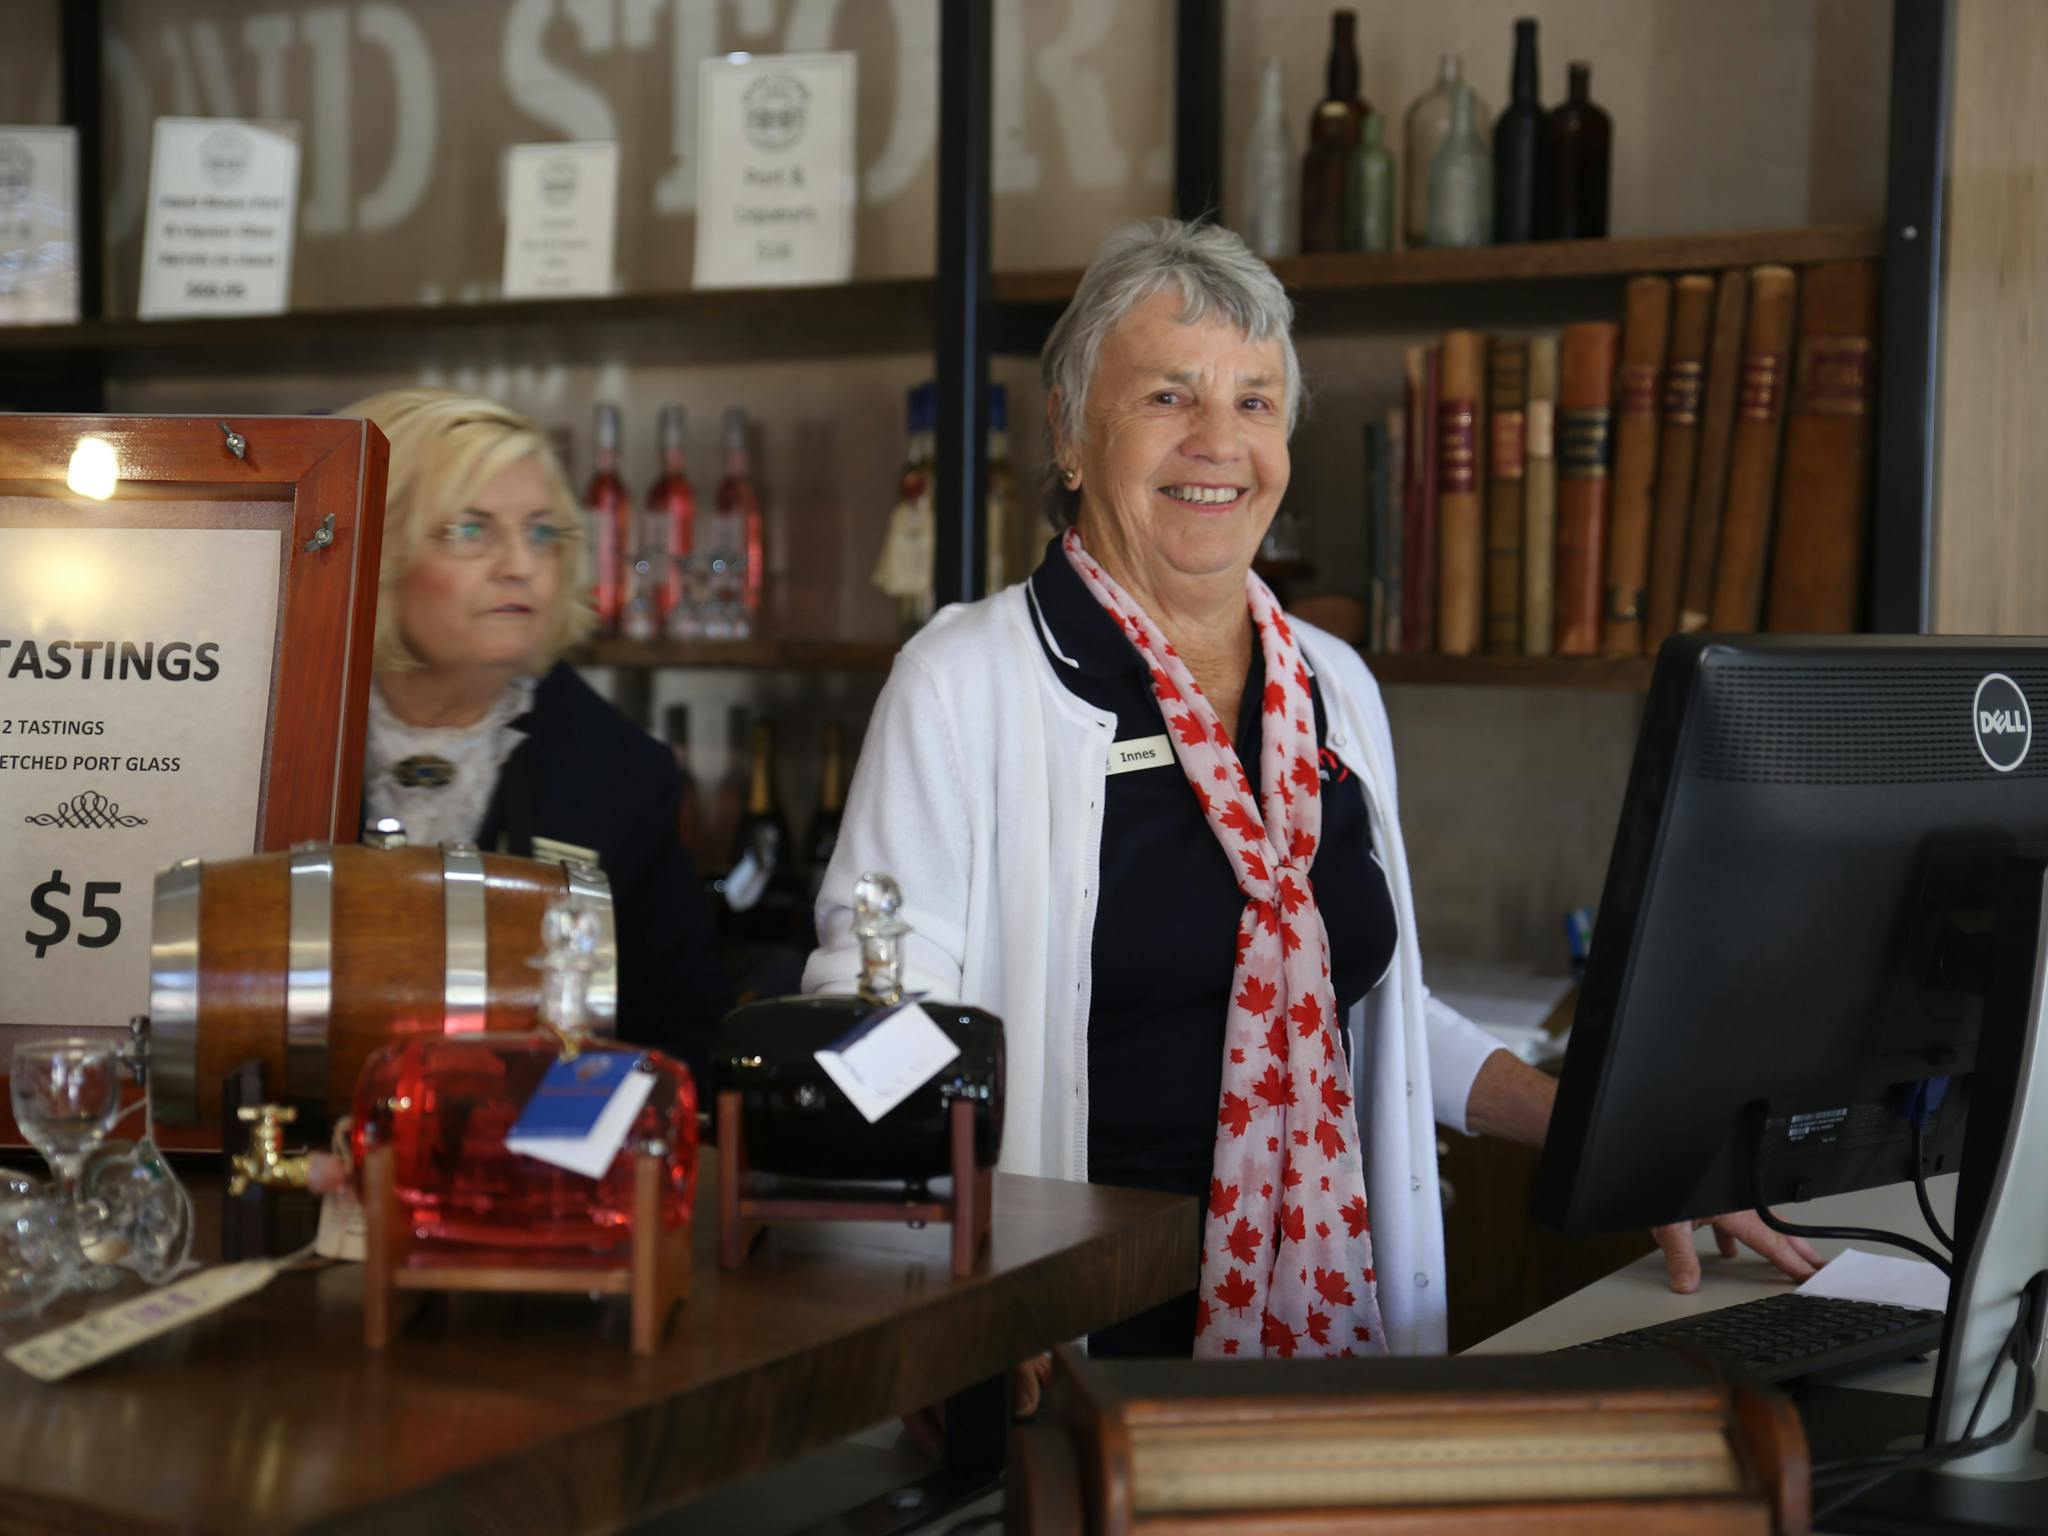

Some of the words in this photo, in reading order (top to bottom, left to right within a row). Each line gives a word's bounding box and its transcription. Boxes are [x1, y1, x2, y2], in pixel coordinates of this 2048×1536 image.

[2, 719, 13, 735] 2
[18, 719, 105, 736] TASTINGS
[1980, 709, 2026, 735] DELL
[0, 754, 68, 771] ETCHED
[72, 755, 122, 772] PORT
[125, 756, 181, 772] GLASS
[1120, 749, 1157, 763] Innes
[25, 869, 122, 959] $5
